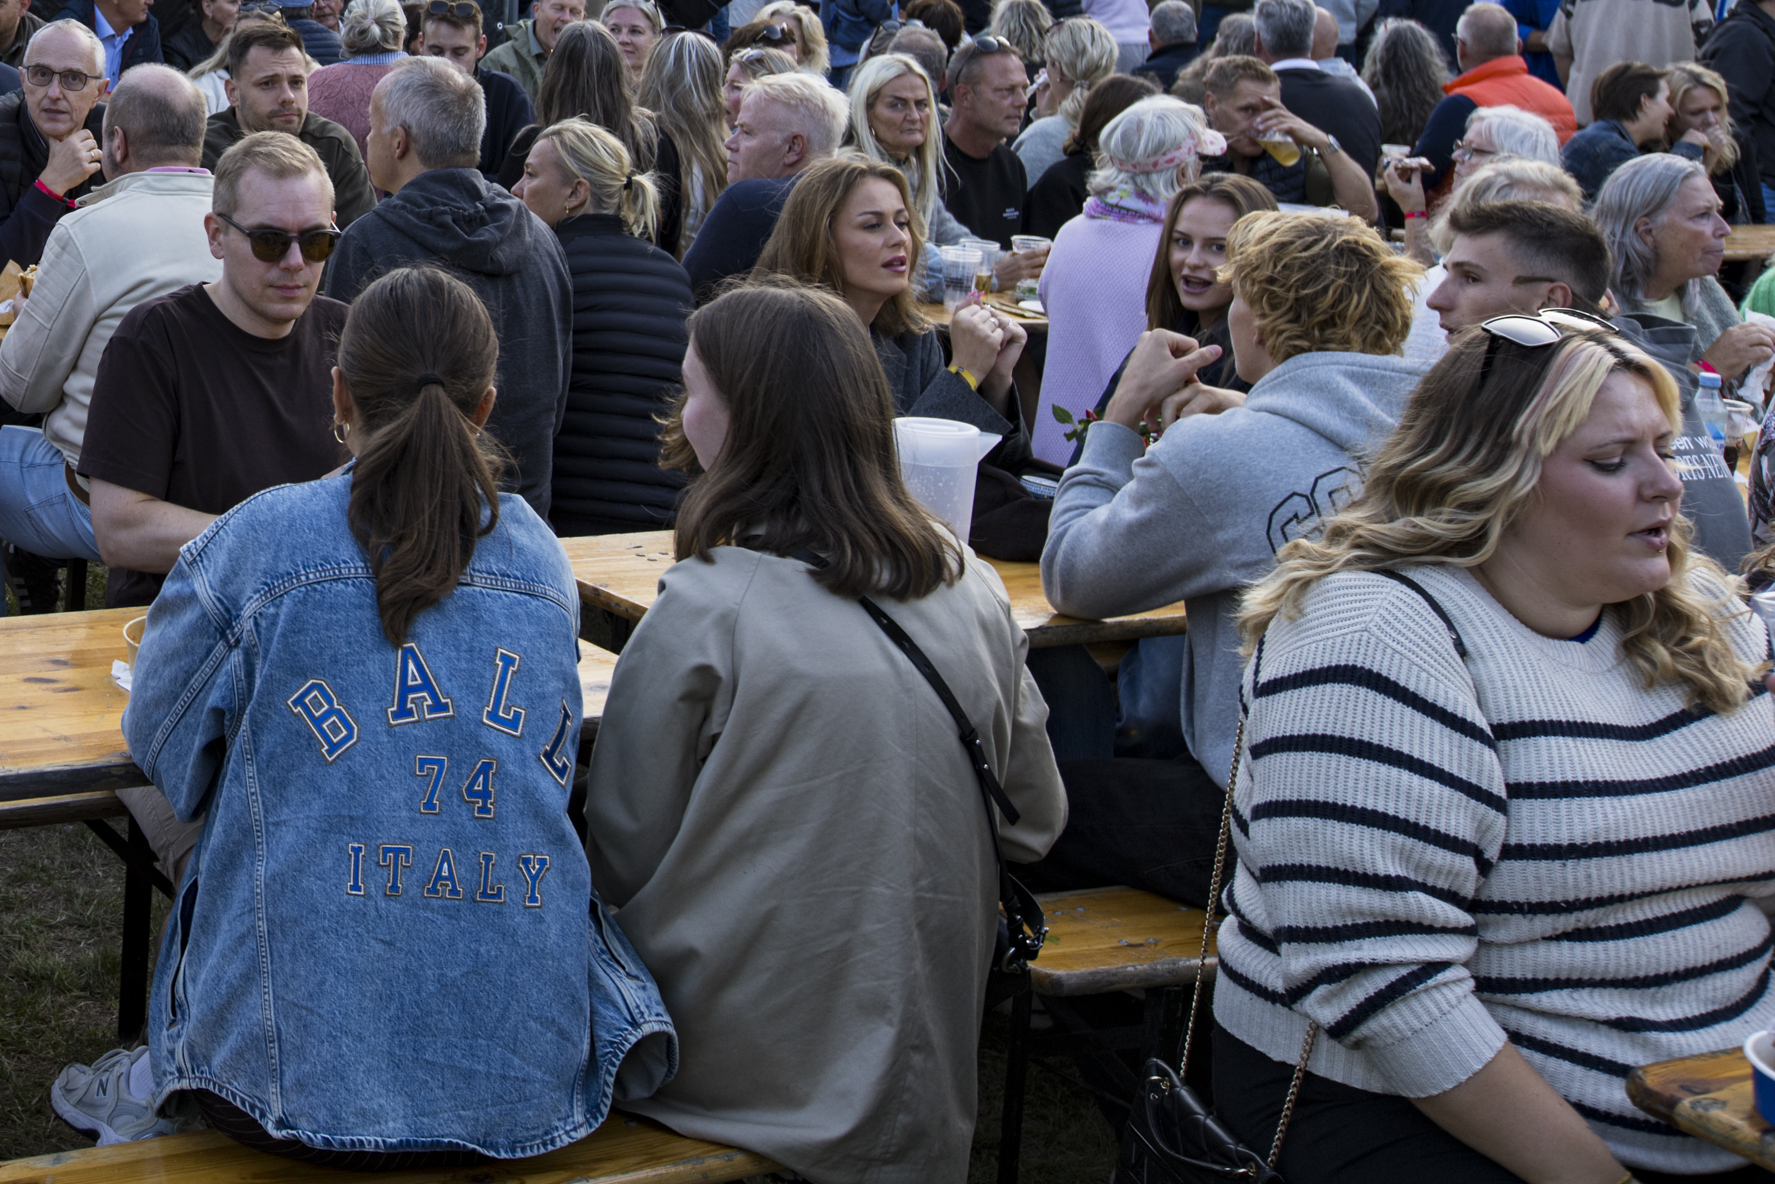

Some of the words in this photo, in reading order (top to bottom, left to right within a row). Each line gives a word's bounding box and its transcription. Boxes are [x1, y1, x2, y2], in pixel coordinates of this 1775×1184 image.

[285, 642, 573, 788] BALL
[414, 754, 498, 819] 74
[346, 843, 551, 909] ITALY
